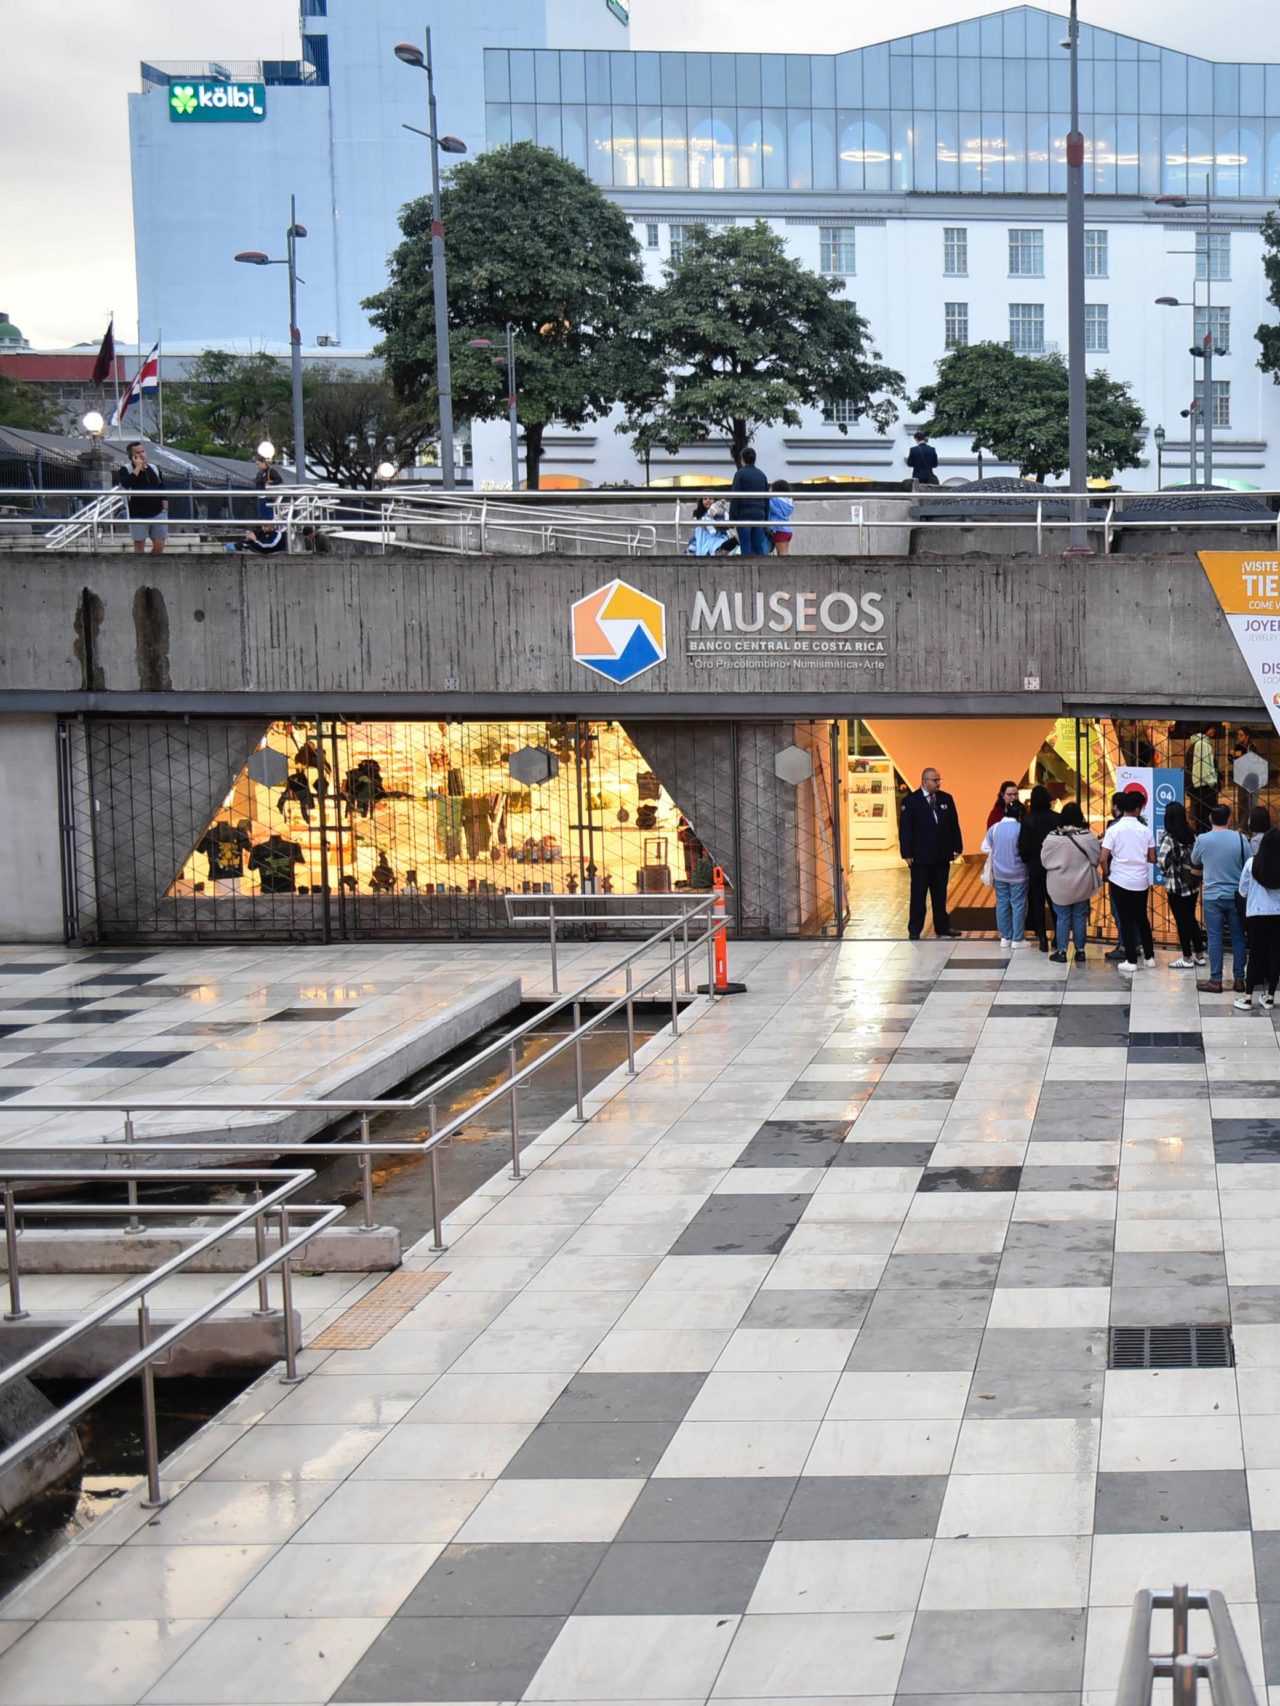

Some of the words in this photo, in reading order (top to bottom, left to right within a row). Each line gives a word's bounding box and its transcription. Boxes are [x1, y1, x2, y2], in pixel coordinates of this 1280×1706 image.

[198, 85, 255, 107] kölbi
[1249, 601, 1275, 610] COME
[690, 590, 885, 633] MUSEOS
[690, 641, 732, 651] BANCO
[735, 641, 791, 651] CENTRAL
[794, 641, 809, 651] DE
[812, 641, 852, 651] COSTA
[855, 642, 884, 651] RICA
[694, 659, 714, 669] Oro
[716, 659, 786, 669] Precolombino
[1160, 791, 1172, 800] 04
